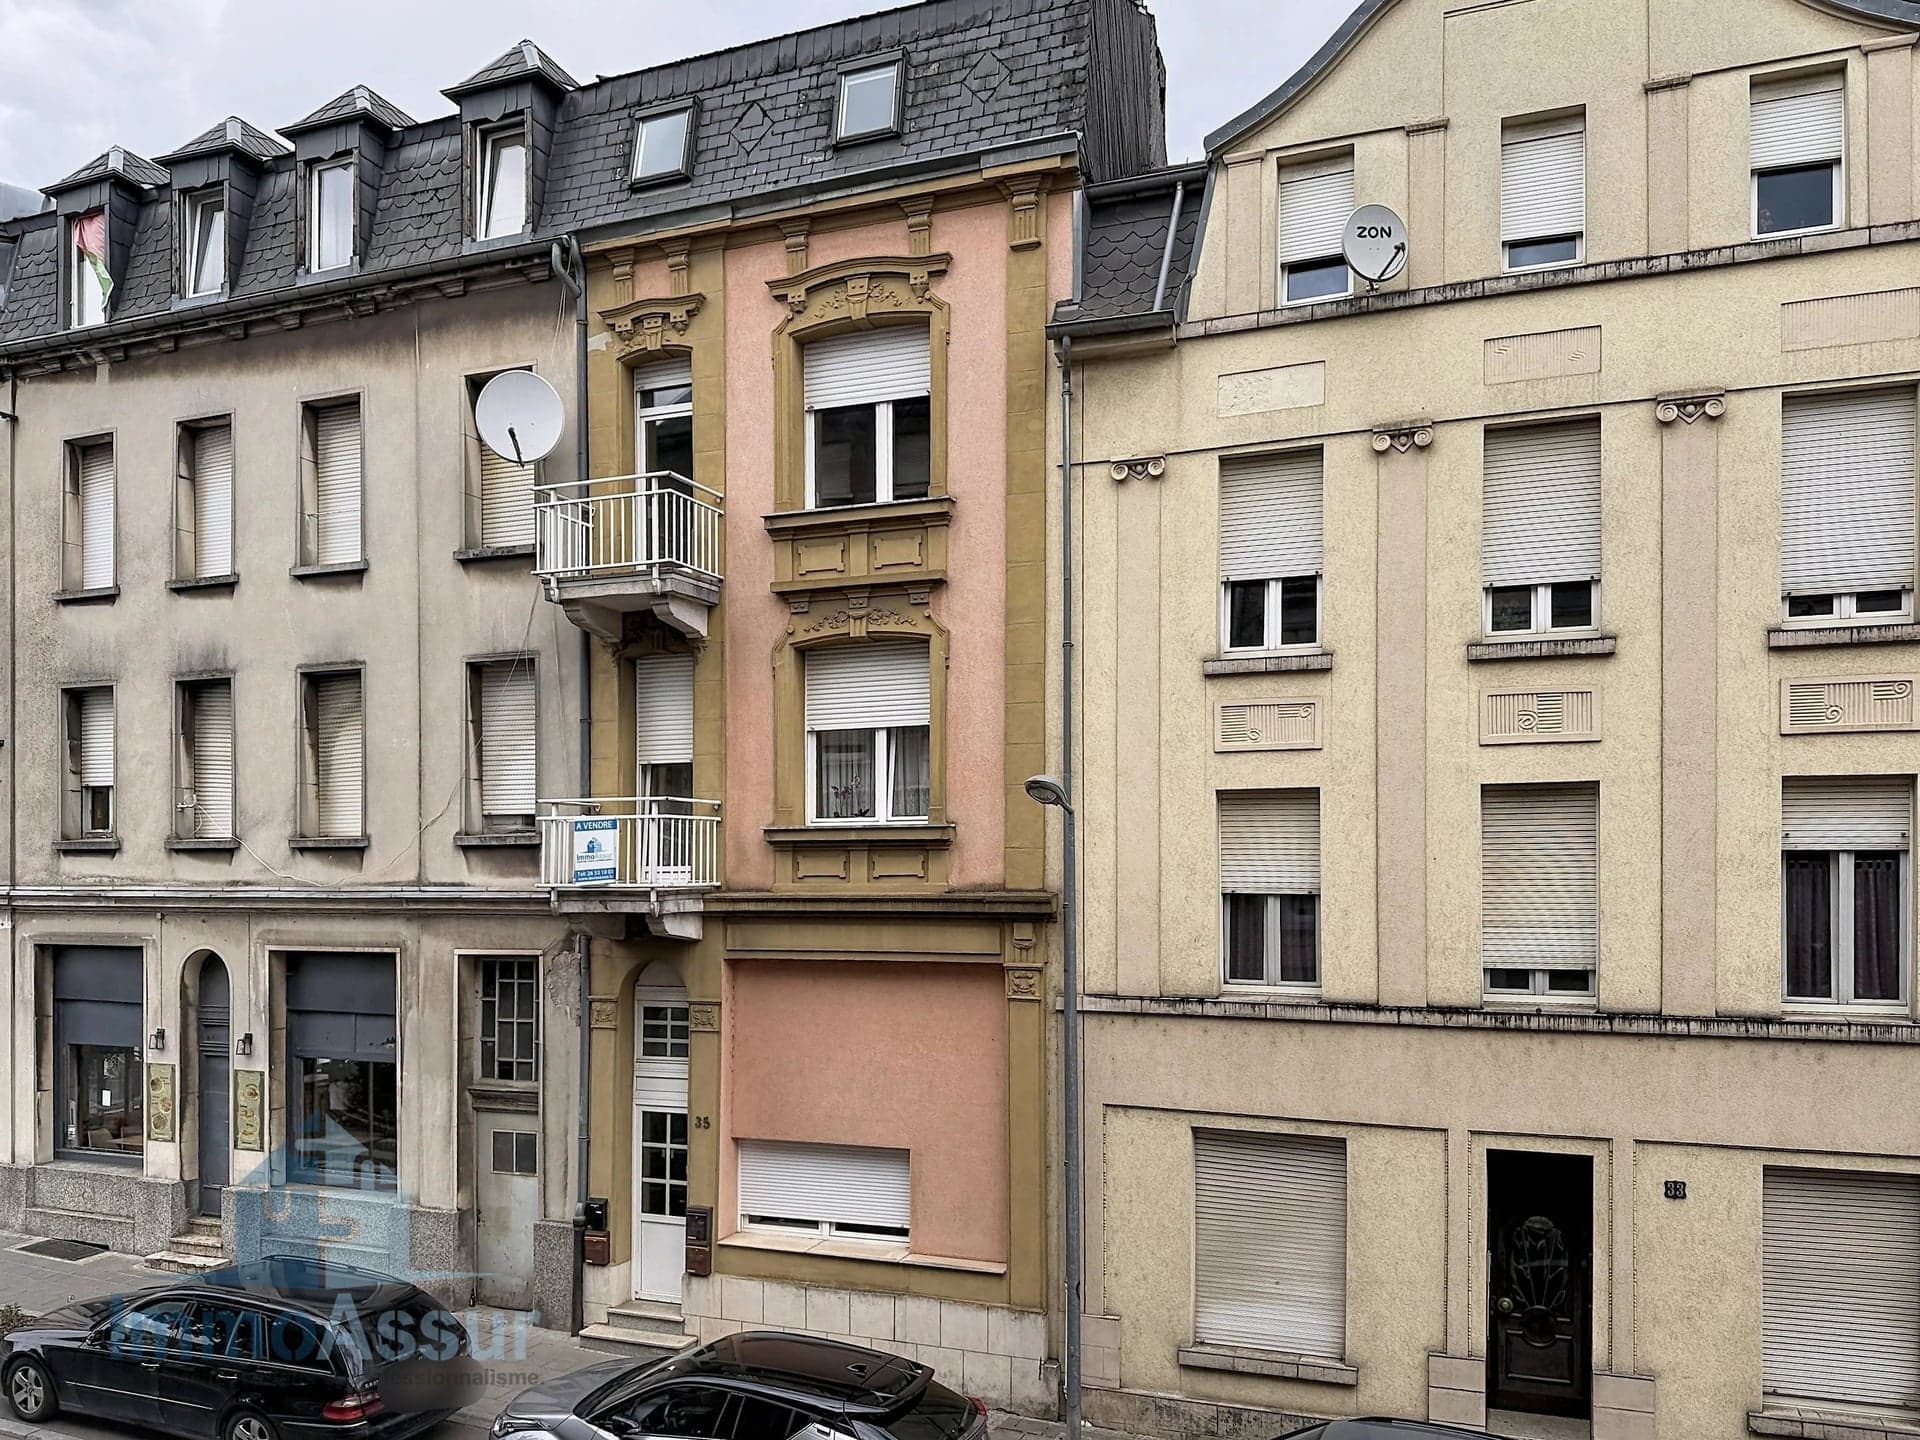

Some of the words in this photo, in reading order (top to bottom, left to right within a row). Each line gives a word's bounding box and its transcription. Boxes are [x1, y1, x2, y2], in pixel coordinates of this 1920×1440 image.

[1357, 226, 1392, 239] ZON
[576, 822, 582, 830] A
[583, 821, 613, 830] VENDRE
[695, 1116, 710, 1130] 35
[1667, 1182, 1684, 1197] 33
